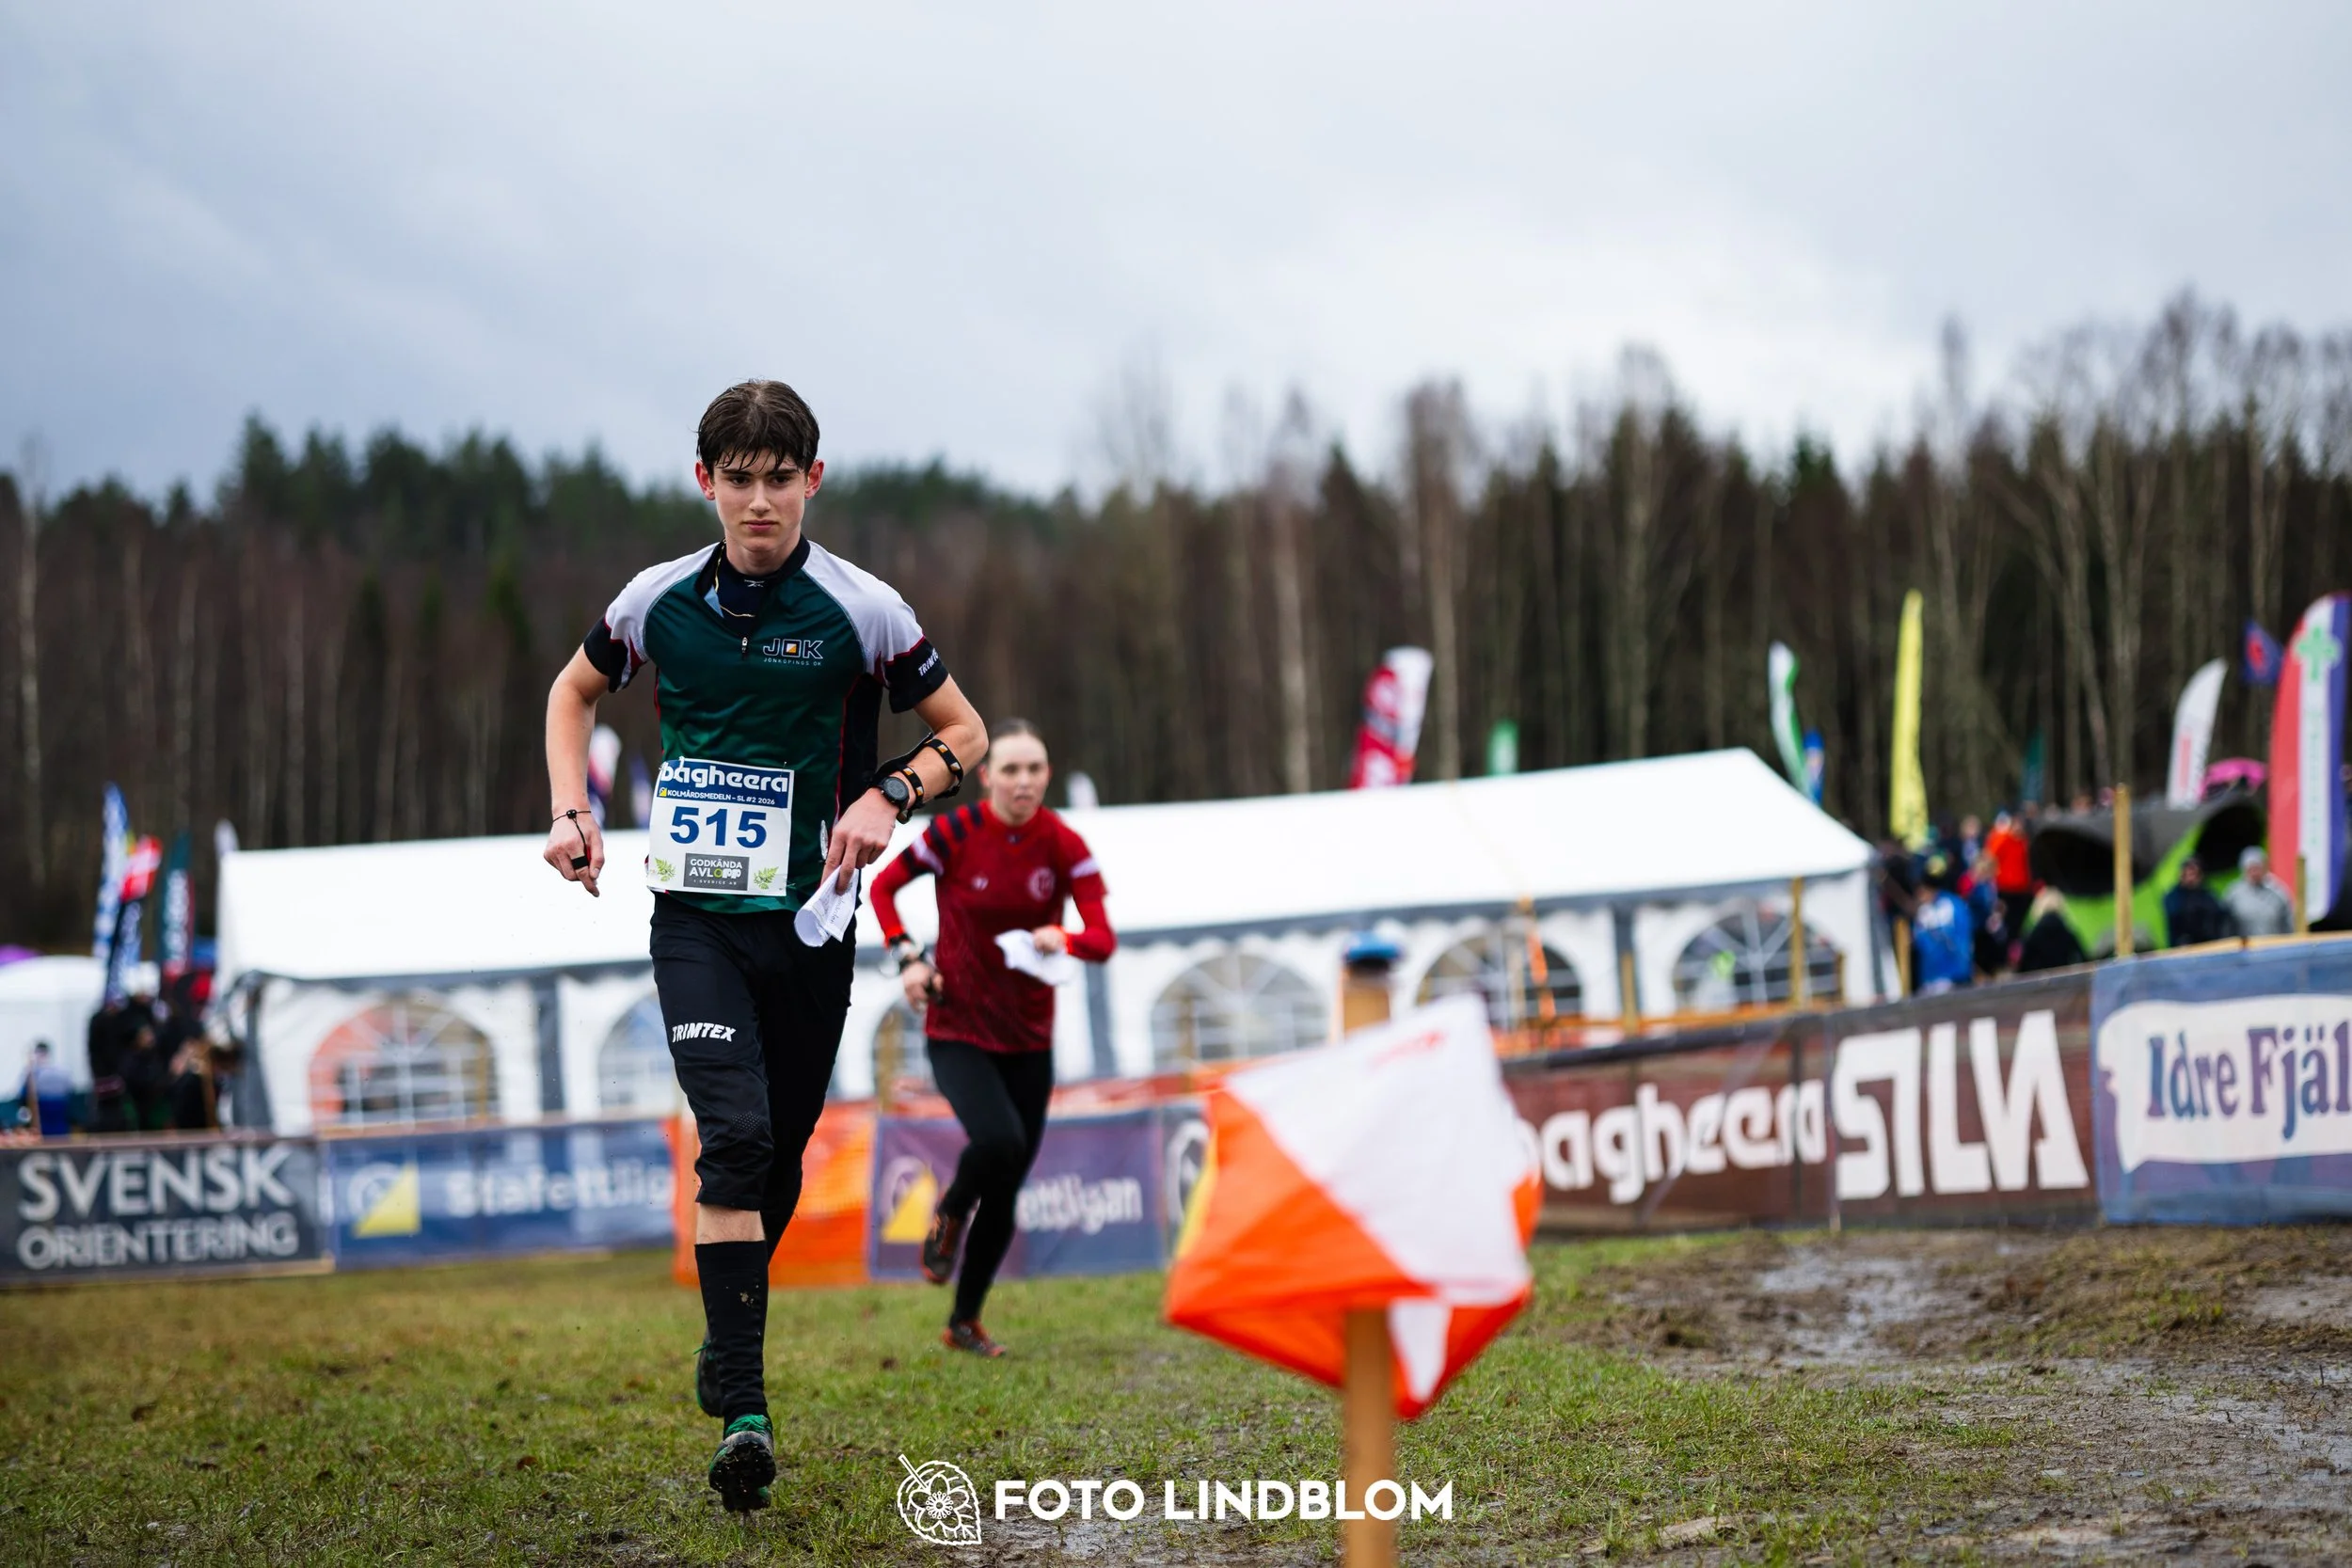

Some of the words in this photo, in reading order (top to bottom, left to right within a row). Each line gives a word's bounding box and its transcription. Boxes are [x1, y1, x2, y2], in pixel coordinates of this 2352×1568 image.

[762, 638, 823, 658] JOK
[660, 762, 788, 792] bagheera
[667, 789, 731, 800] KOLMÅRDSMEDELN
[670, 806, 767, 848] 515
[690, 858, 742, 869] GODKÄNDA
[672, 1022, 737, 1043] TRIMTEX
[2146, 1029, 2239, 1120] Idre
[1834, 1008, 2090, 1200] SILVA
[17, 1145, 295, 1221] SVENSK
[16, 1211, 299, 1269] ORIENTERING
